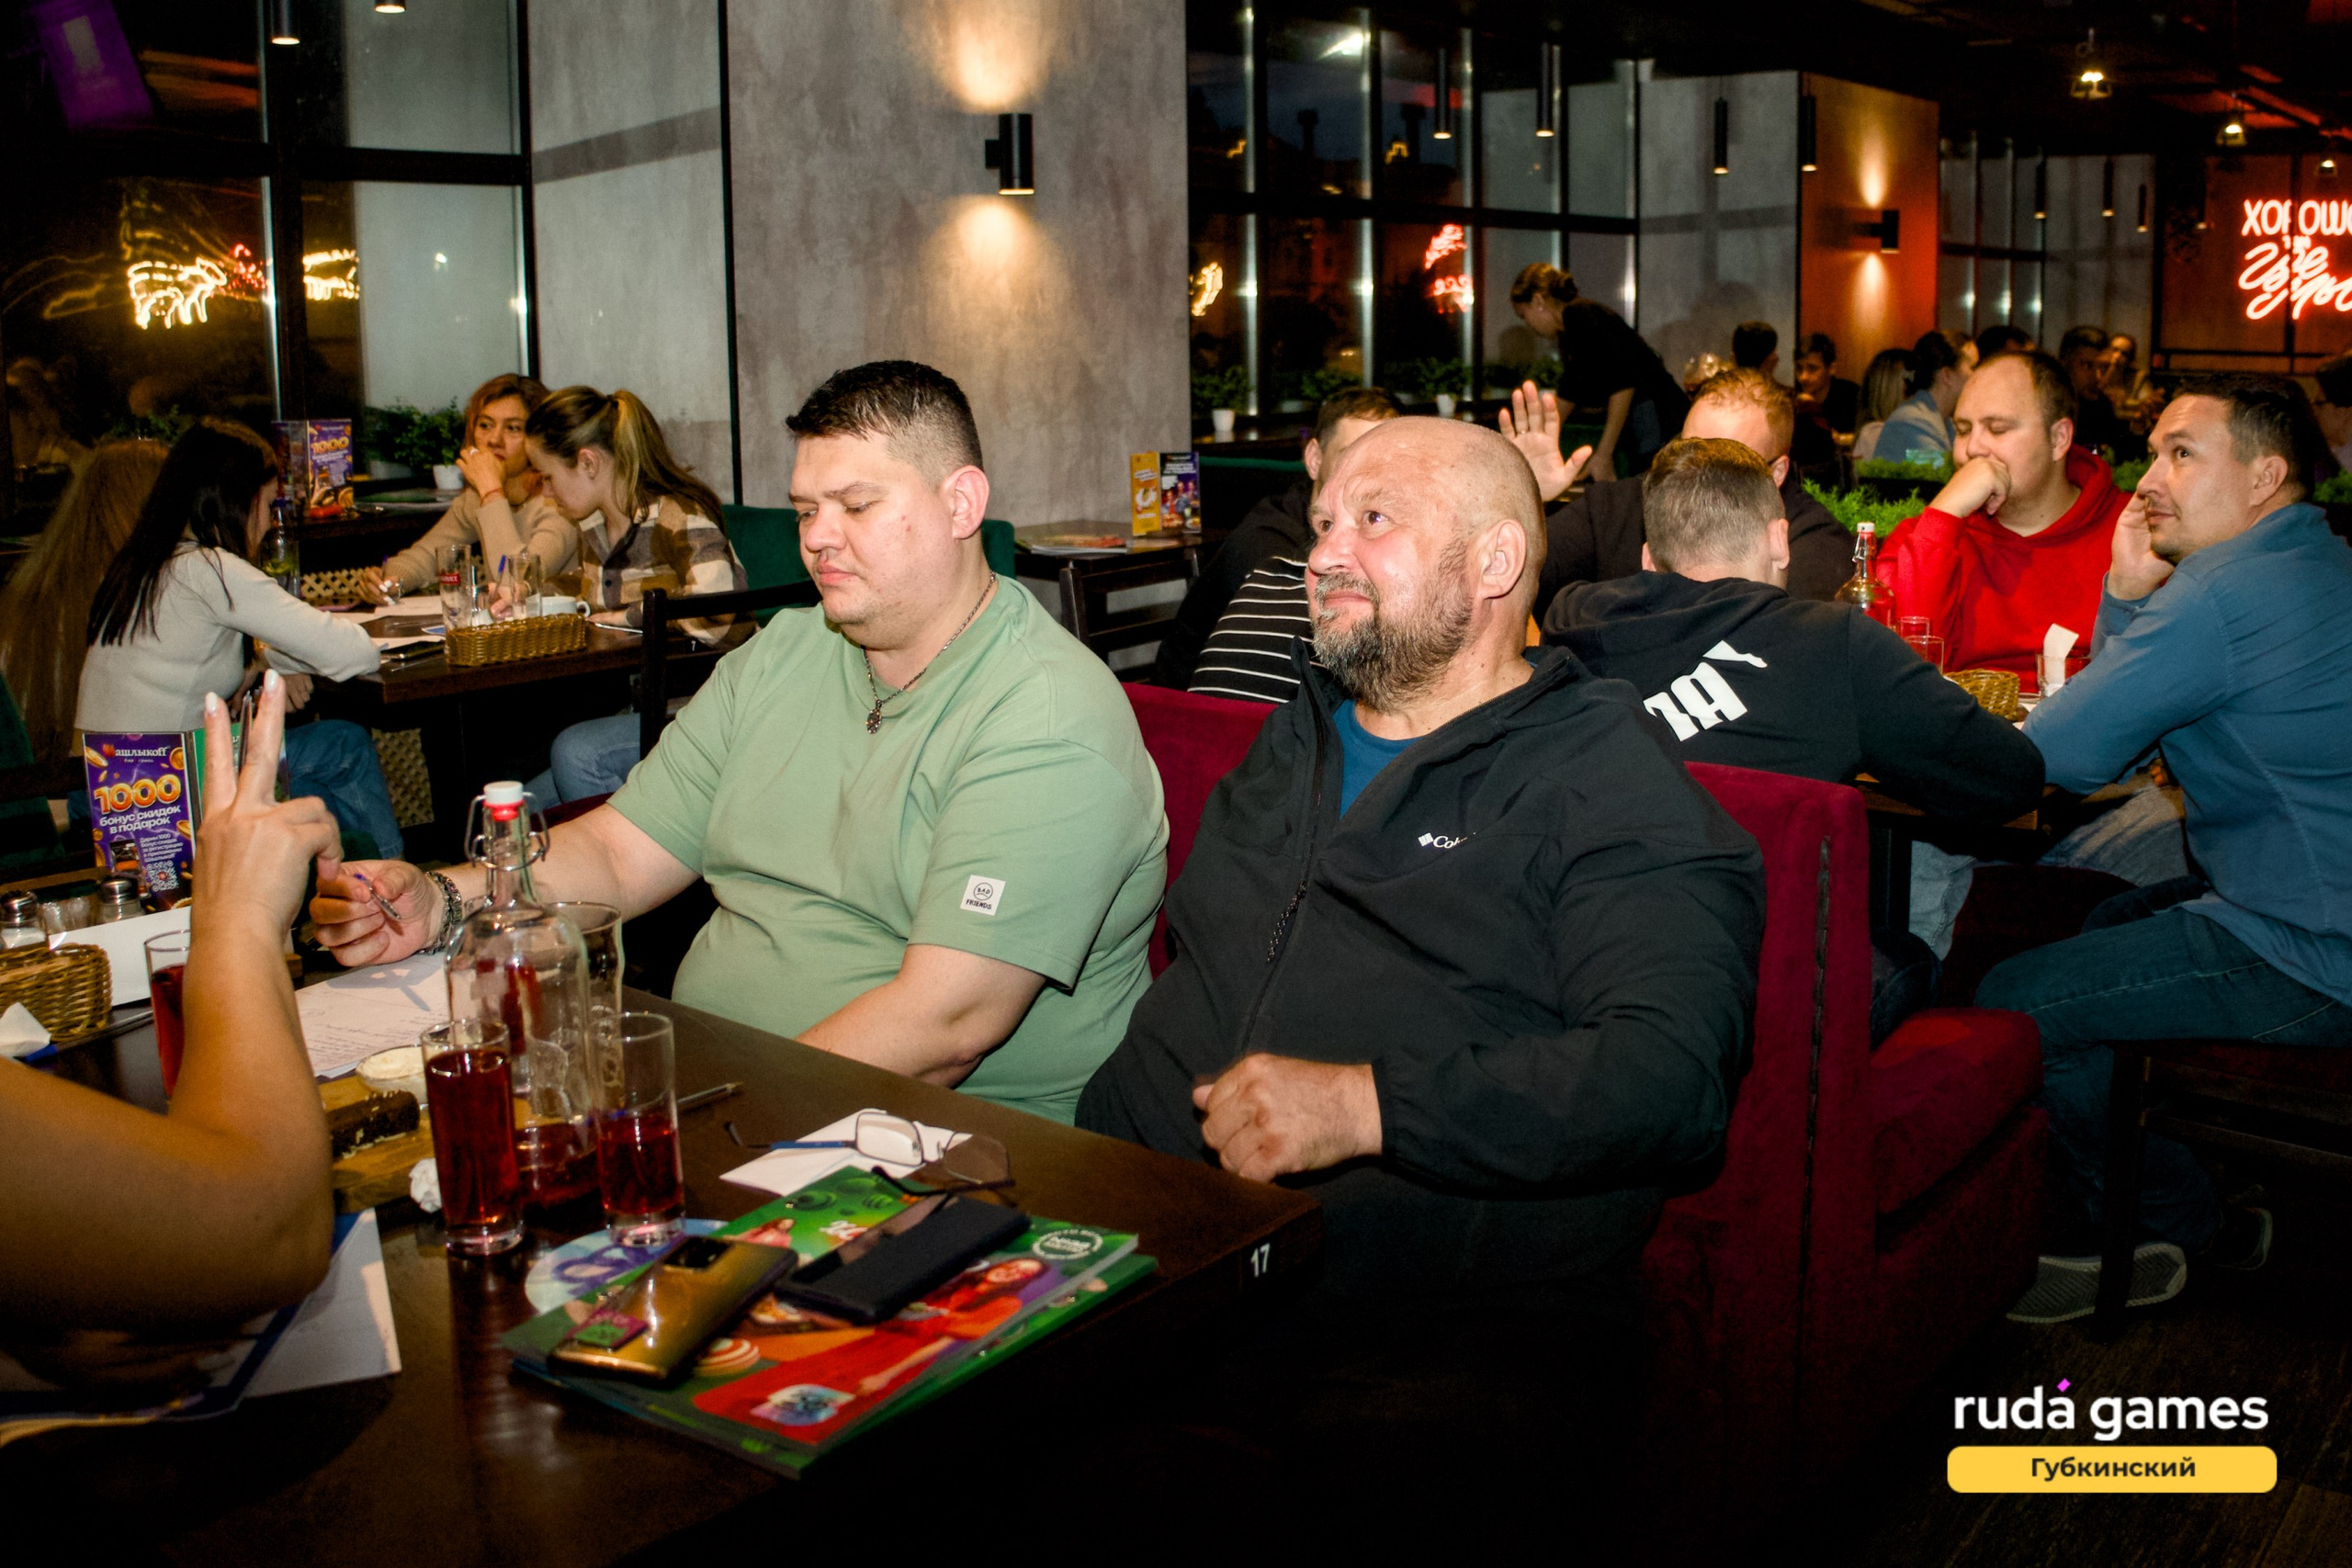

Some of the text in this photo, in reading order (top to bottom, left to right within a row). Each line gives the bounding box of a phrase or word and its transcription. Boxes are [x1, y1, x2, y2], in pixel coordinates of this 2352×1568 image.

[94, 774, 181, 815] 1000
[100, 806, 181, 827] бонус скидок
[110, 817, 171, 834] в подарок
[966, 899, 992, 909] FRIENDS
[1250, 1242, 1271, 1278] 17
